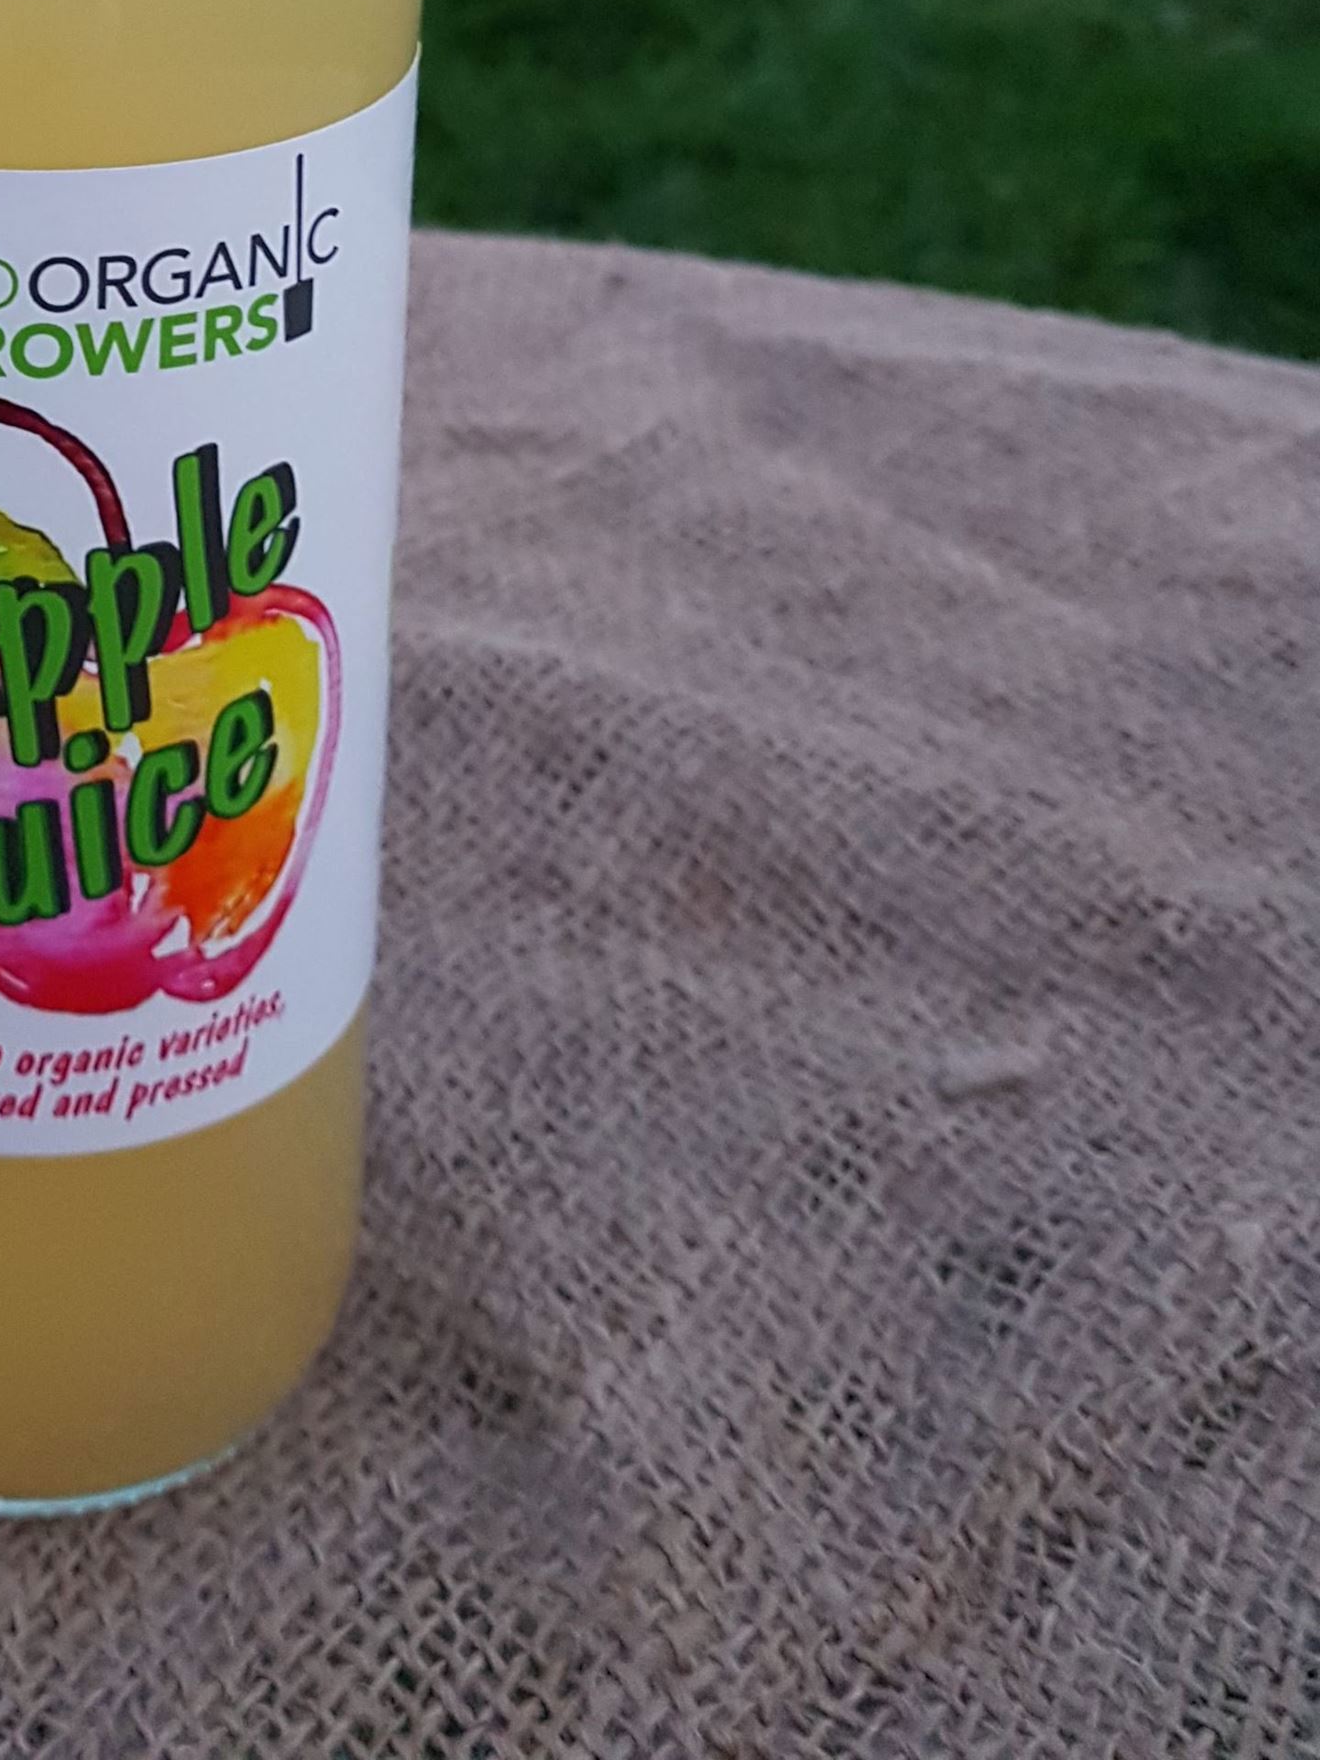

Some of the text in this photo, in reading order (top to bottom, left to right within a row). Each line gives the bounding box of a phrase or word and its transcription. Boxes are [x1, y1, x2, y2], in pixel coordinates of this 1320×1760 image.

[15, 1036, 145, 1086] organic
[53, 1080, 126, 1119] and
[125, 1038, 250, 1121] pressed
